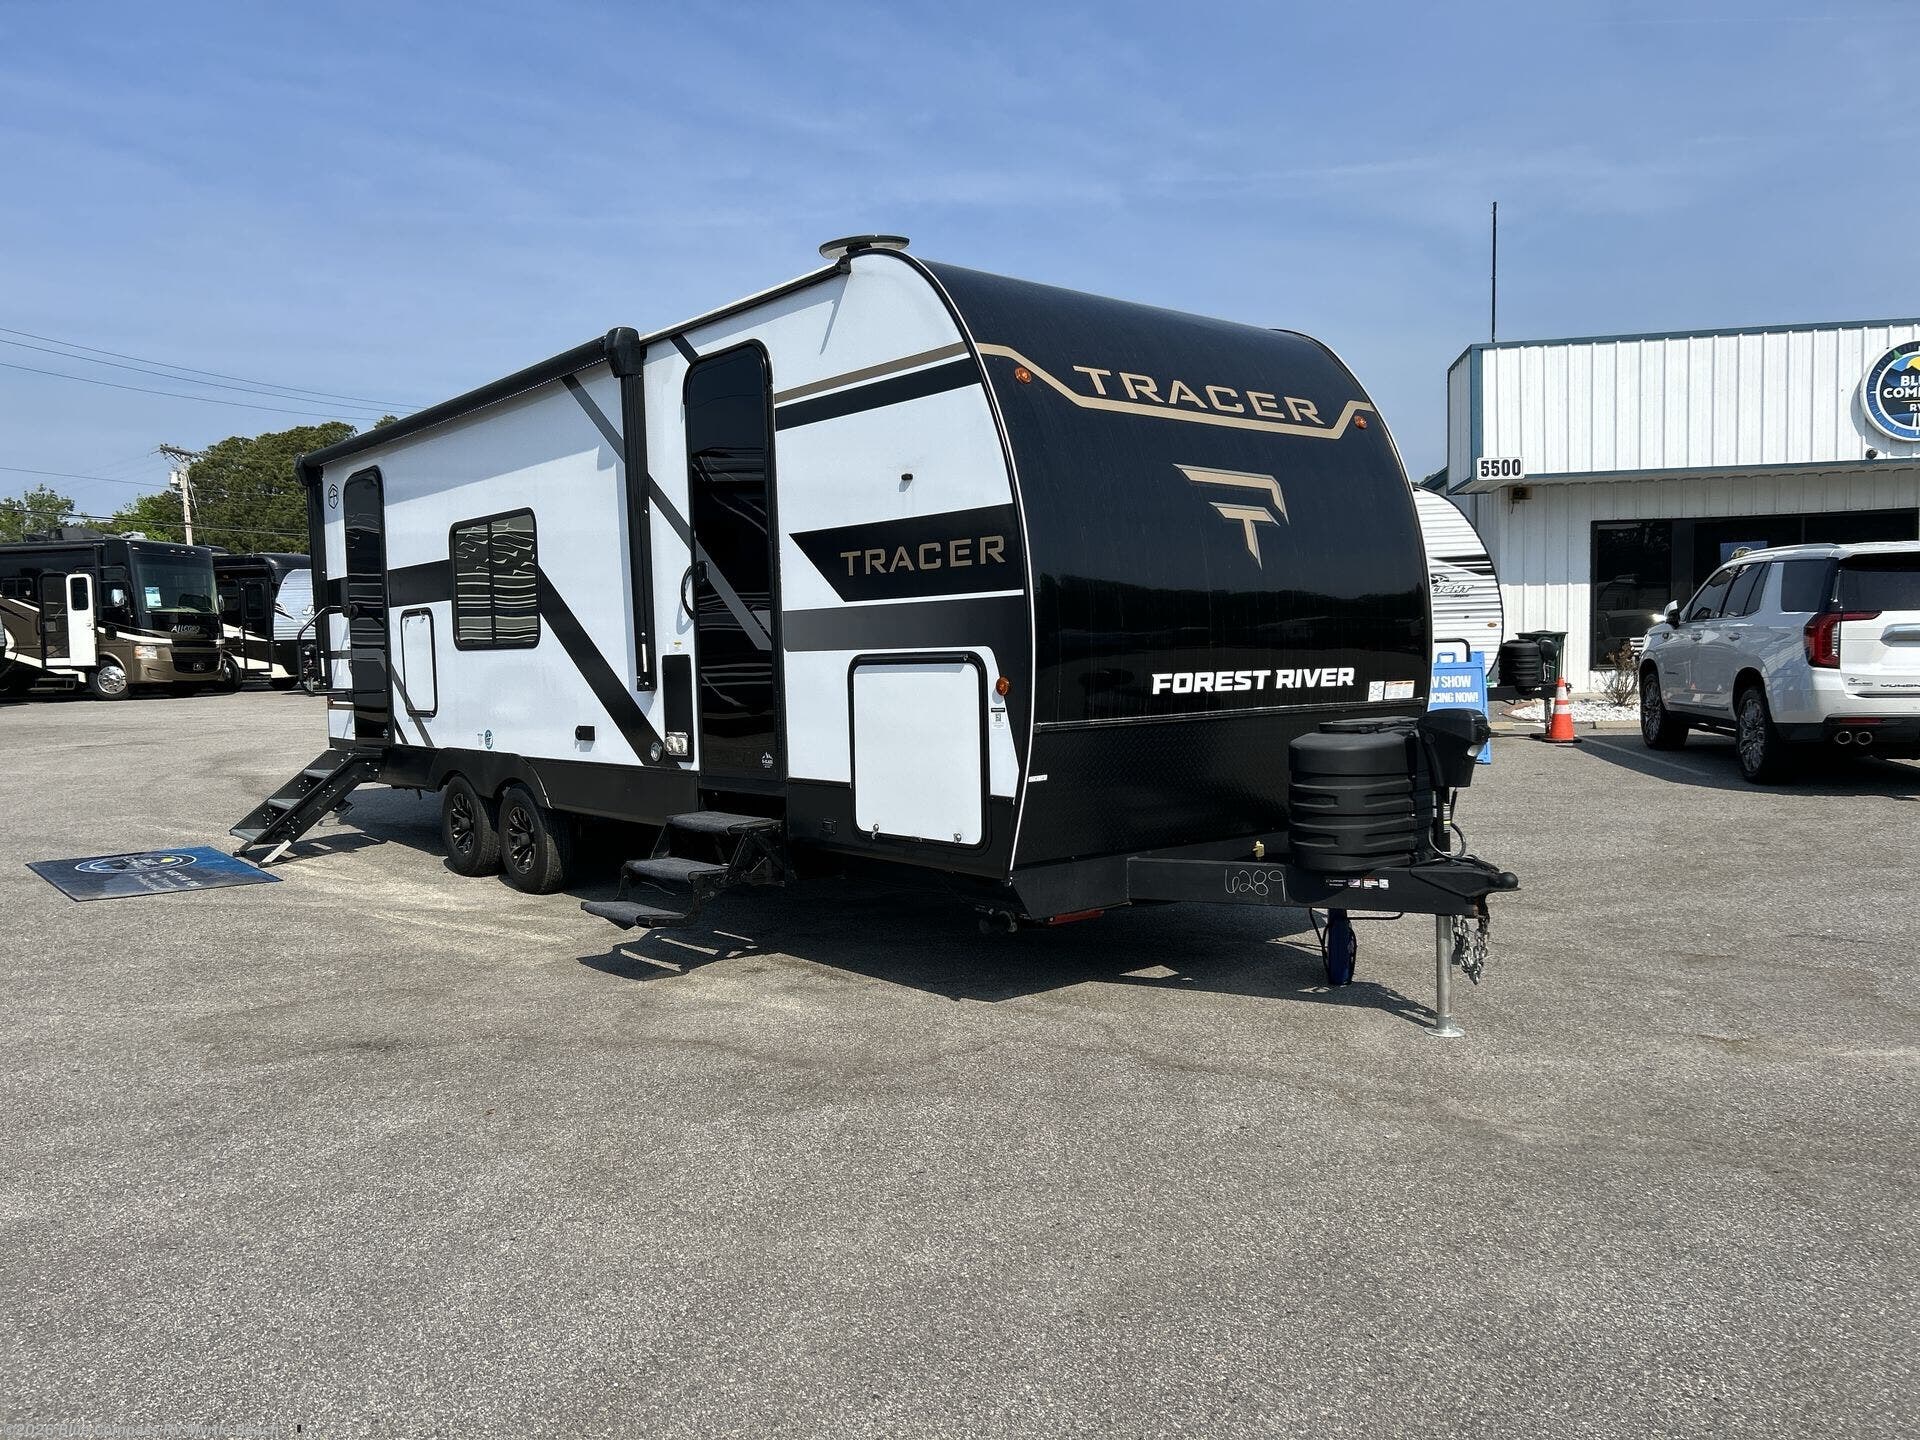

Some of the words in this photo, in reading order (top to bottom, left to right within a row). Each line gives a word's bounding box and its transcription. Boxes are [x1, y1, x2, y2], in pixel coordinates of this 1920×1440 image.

[1900, 375, 1920, 387] BL
[1072, 365, 1325, 425] TRACER
[1883, 387, 1920, 398] COM
[1481, 459, 1521, 477] 5500
[840, 535, 1006, 576] TRACER
[1432, 584, 1474, 594] LIGHT
[1152, 670, 1271, 695] FOREST
[1276, 667, 1355, 689] RIVER
[1441, 675, 1471, 688] SHOW
[1454, 691, 1479, 703] NOW!
[1225, 869, 1287, 902] 6289
